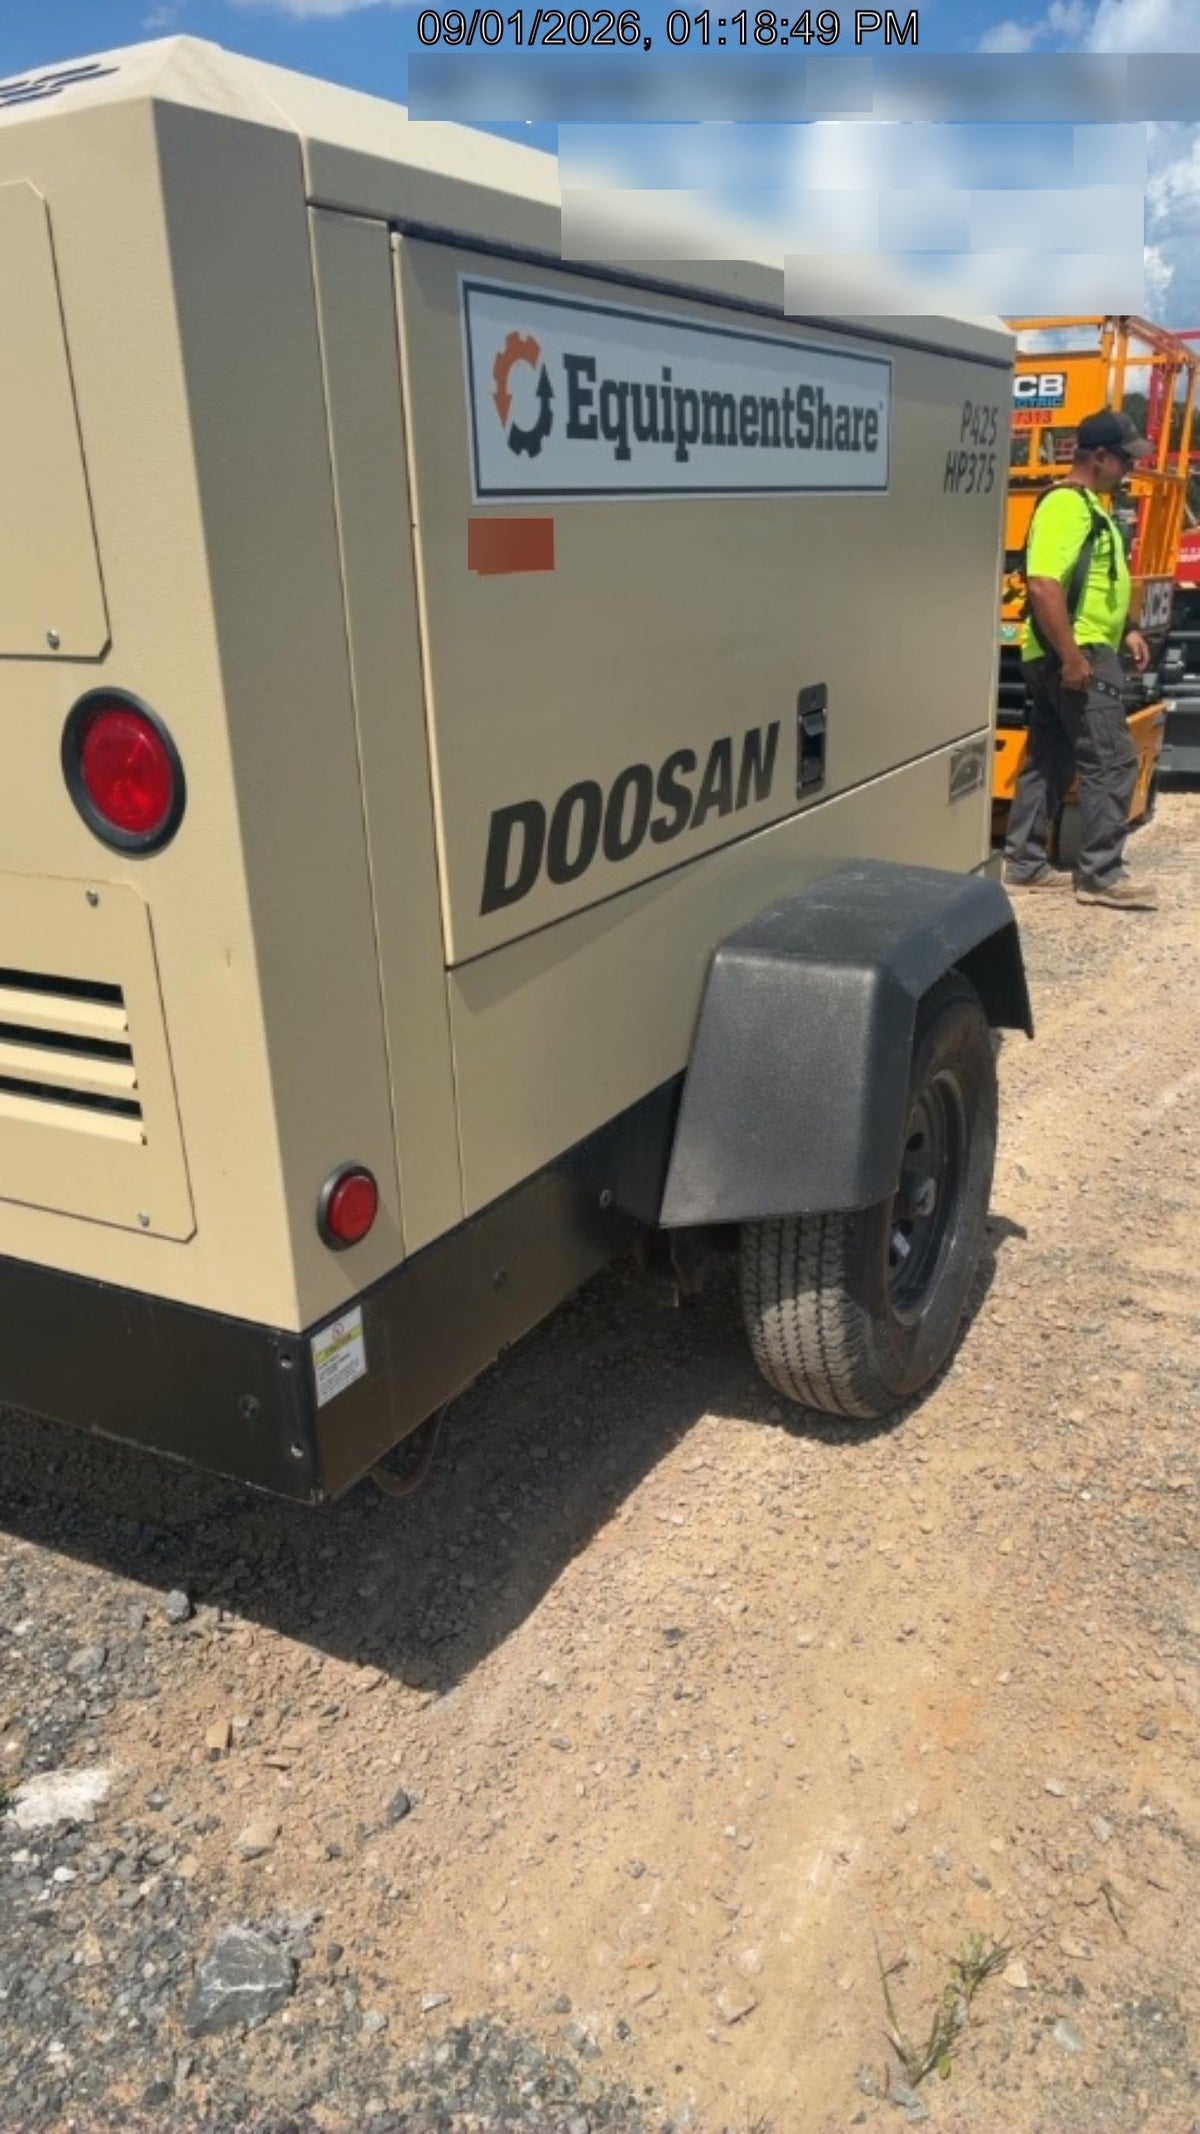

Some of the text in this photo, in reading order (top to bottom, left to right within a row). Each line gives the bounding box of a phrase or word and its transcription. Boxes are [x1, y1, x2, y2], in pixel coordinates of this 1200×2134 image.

[562, 352, 880, 463] EquipmentShare
[1012, 374, 1064, 397] CB
[960, 399, 999, 447] P425
[1013, 410, 1053, 425] 7313
[943, 449, 997, 494] HP375
[1139, 582, 1173, 629] JCB
[479, 720, 781, 917] DOOSAN
